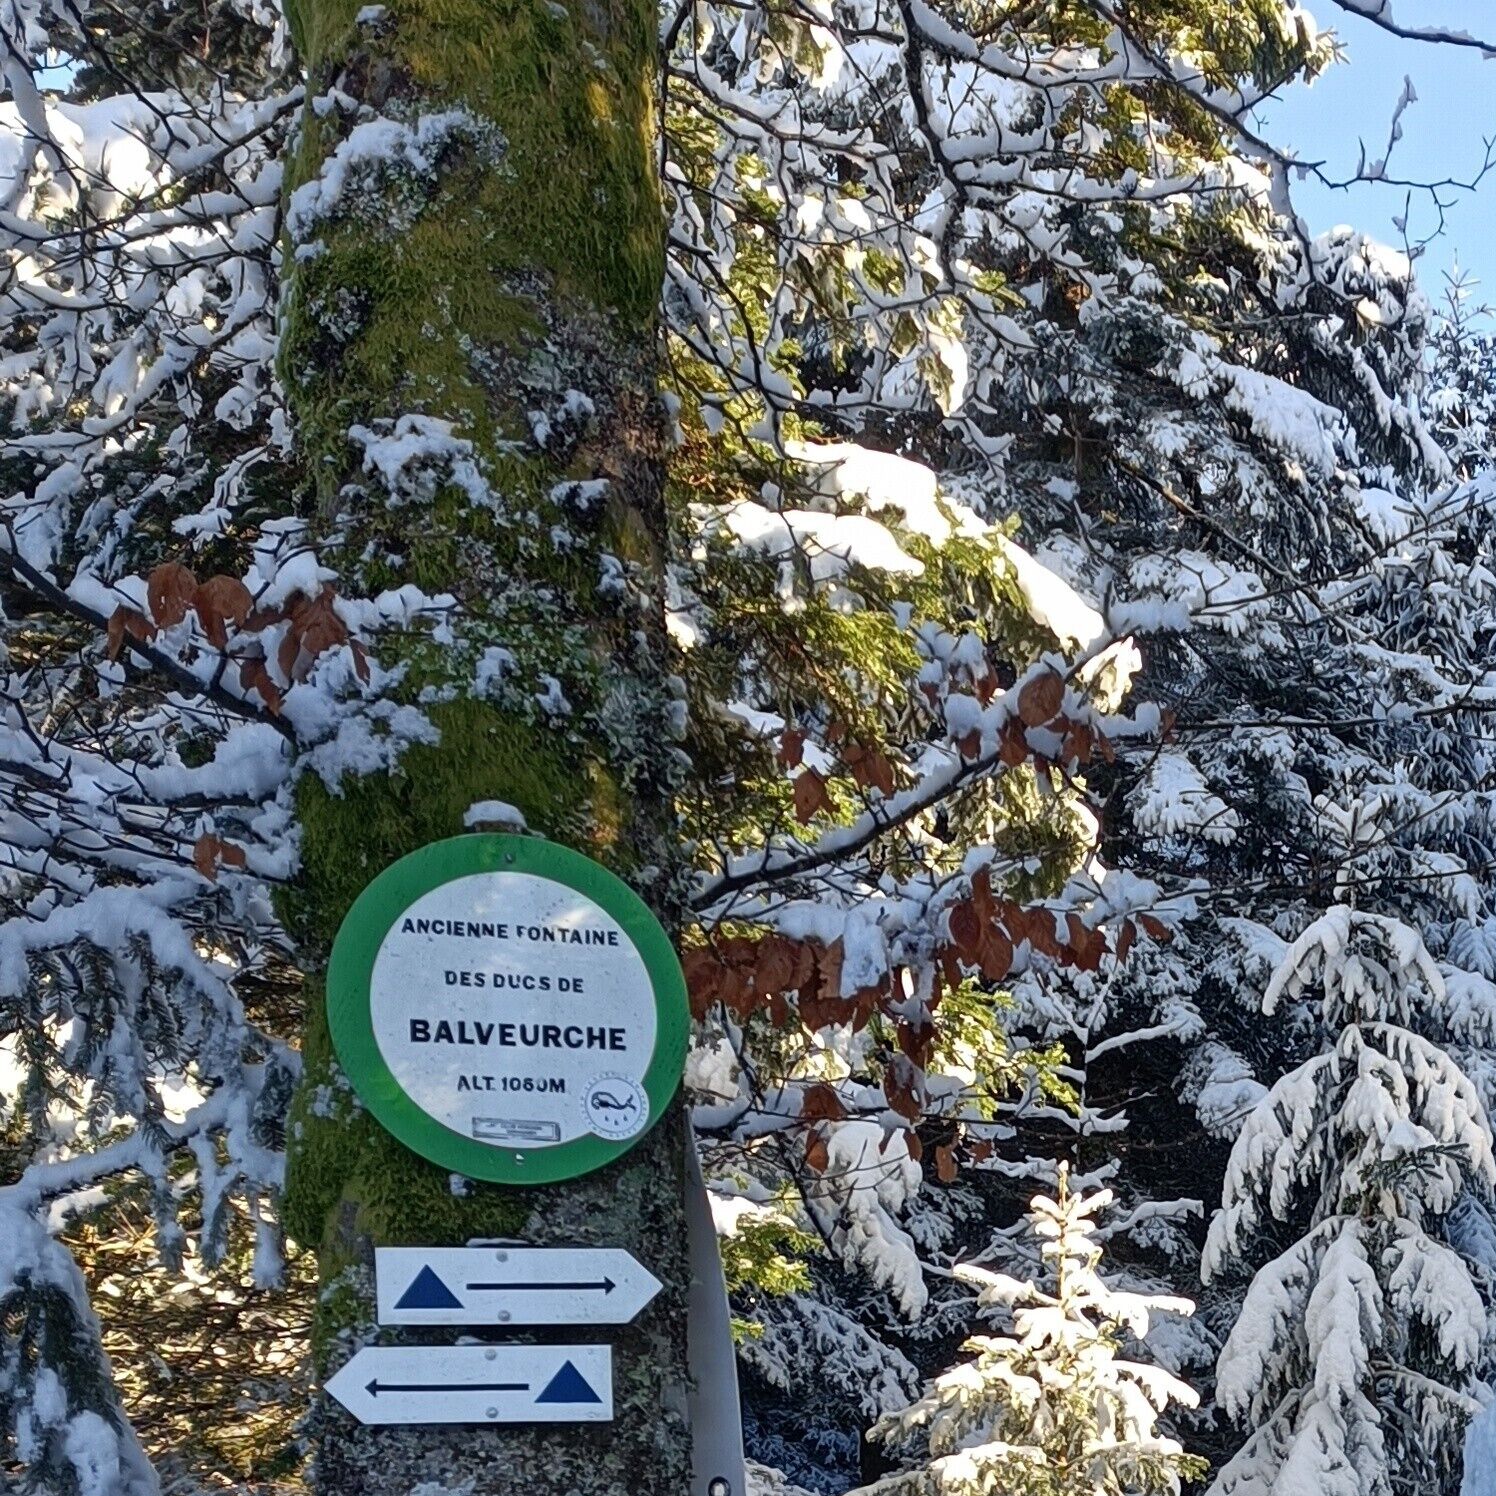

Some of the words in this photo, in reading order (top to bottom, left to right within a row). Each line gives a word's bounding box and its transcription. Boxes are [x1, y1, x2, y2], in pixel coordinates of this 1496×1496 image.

[401, 918, 508, 939] ANCIENNE
[517, 924, 619, 946] FONTAINE
[444, 970, 485, 988] DES
[492, 974, 550, 992] DUCS
[558, 977, 584, 993] DE
[410, 1019, 627, 1051] BALVEURCHE
[501, 1077, 566, 1093] 1060M
